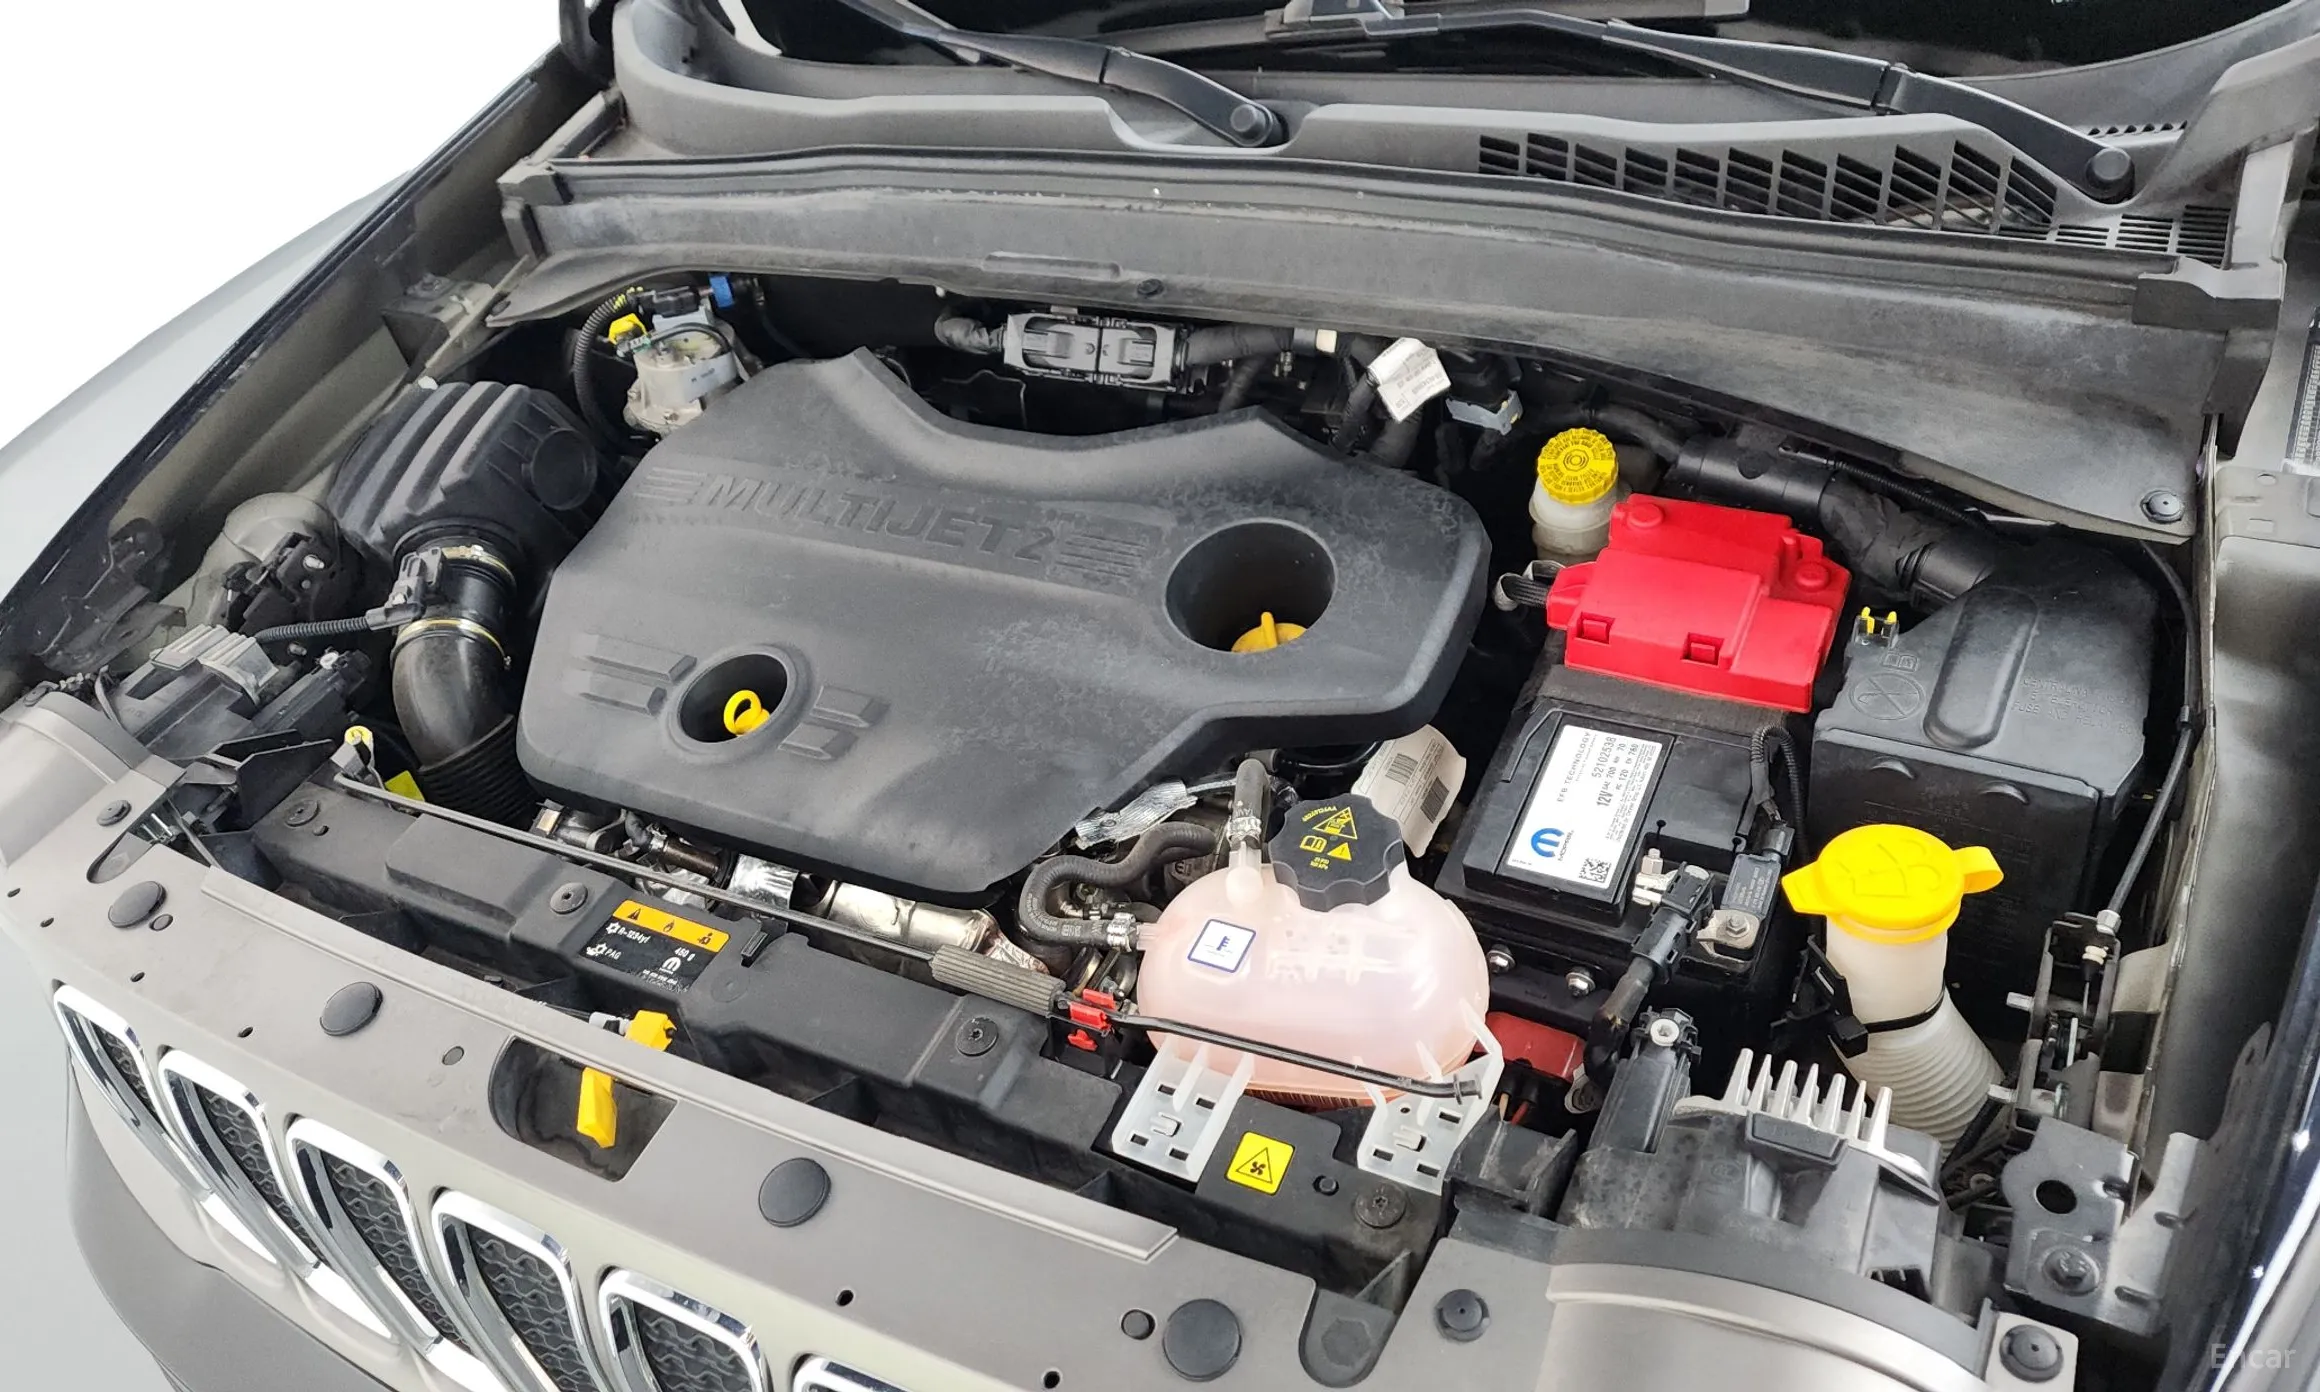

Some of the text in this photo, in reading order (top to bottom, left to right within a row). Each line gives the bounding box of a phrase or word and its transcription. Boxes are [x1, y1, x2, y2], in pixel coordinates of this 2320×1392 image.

[707, 475, 1021, 553] MULTIJET
[1556, 787, 1569, 803] EFB
[1564, 731, 1591, 785] TECHNOLOGY
[1591, 736, 1617, 779] 52102538
[1596, 789, 1614, 807] 12V
[1617, 743, 1626, 752] 70
[1618, 769, 1629, 782] 120
[605, 948, 621, 960] PAG
